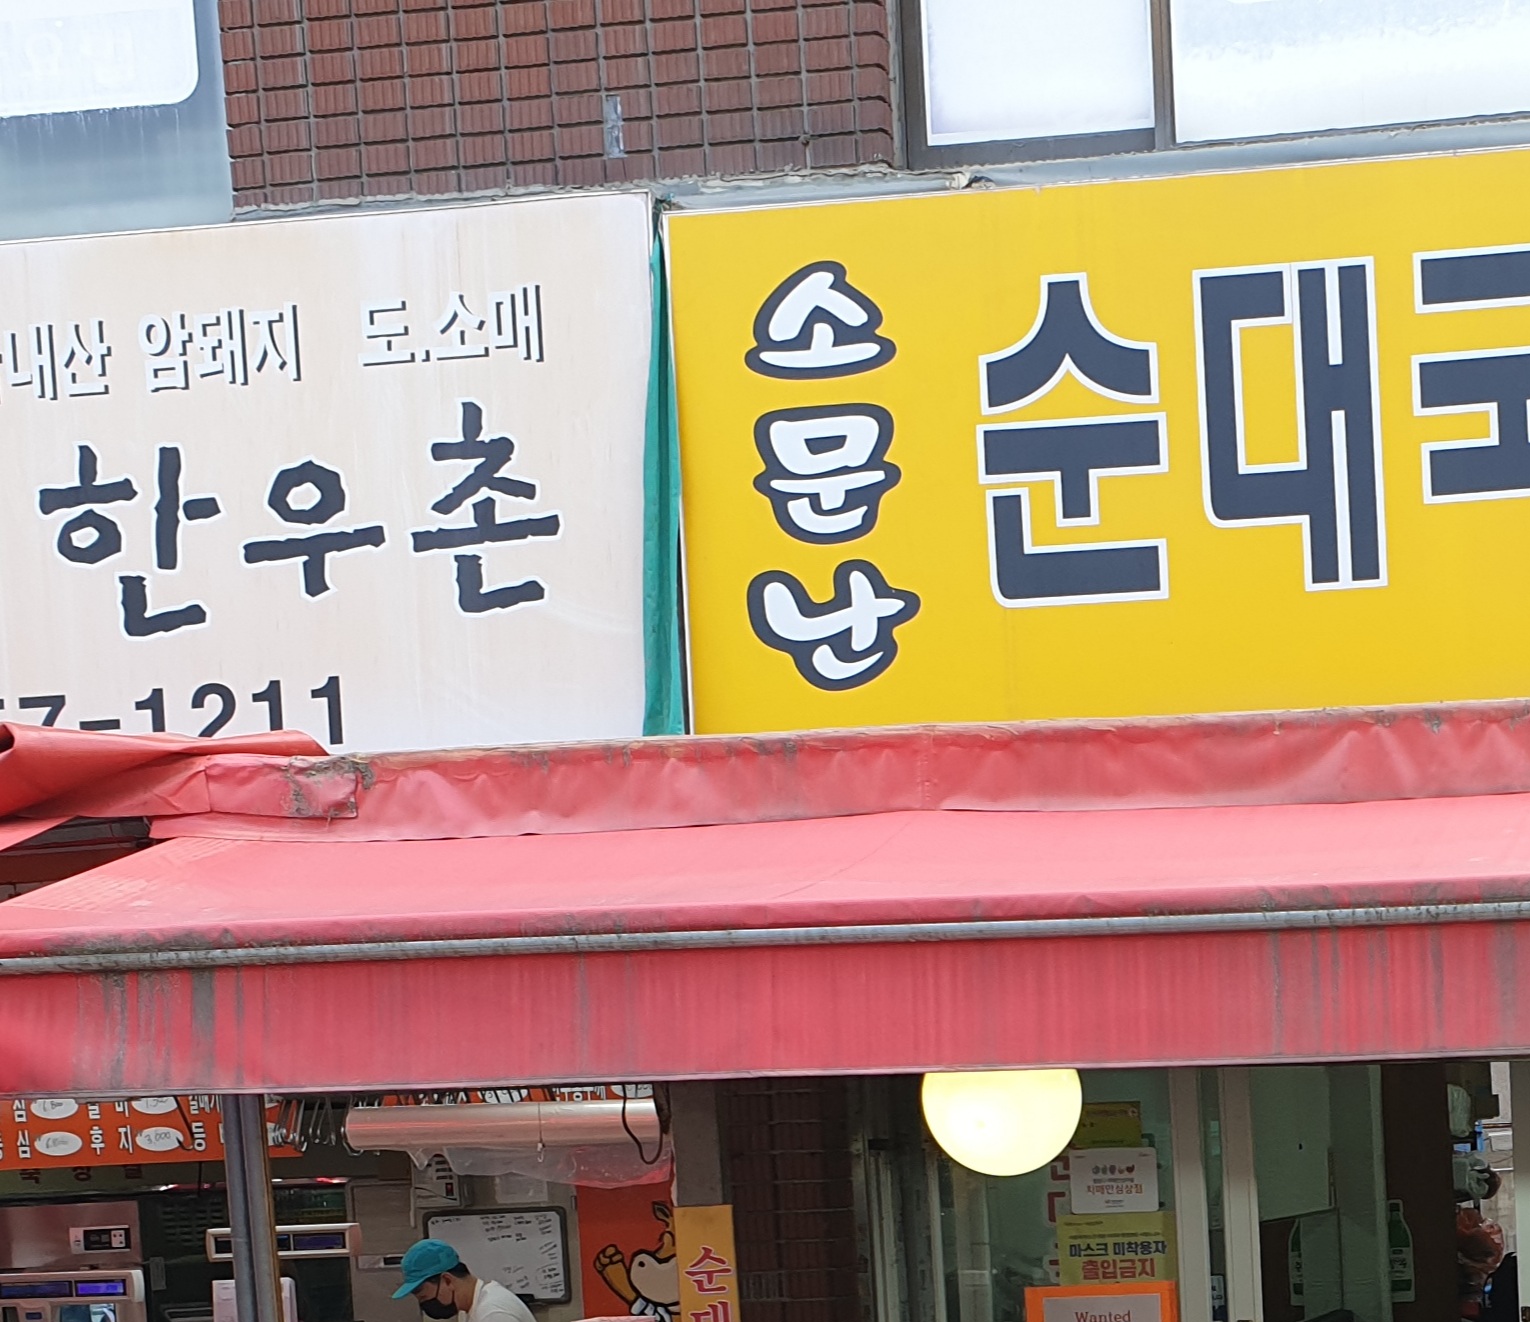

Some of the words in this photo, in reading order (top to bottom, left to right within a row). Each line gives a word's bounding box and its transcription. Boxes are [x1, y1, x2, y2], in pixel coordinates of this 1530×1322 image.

[0, 317, 112, 401] 내산
[138, 303, 303, 393] 암돼지
[744, 260, 920, 691] 소문난
[38, 400, 563, 638] 한우촌
[0, 675, 346, 746] 7-1211
[1069, 1242, 1109, 1258] 마스크
[1113, 1240, 1168, 1256] 미착용자
[1082, 1258, 1157, 1280] 출입금지
